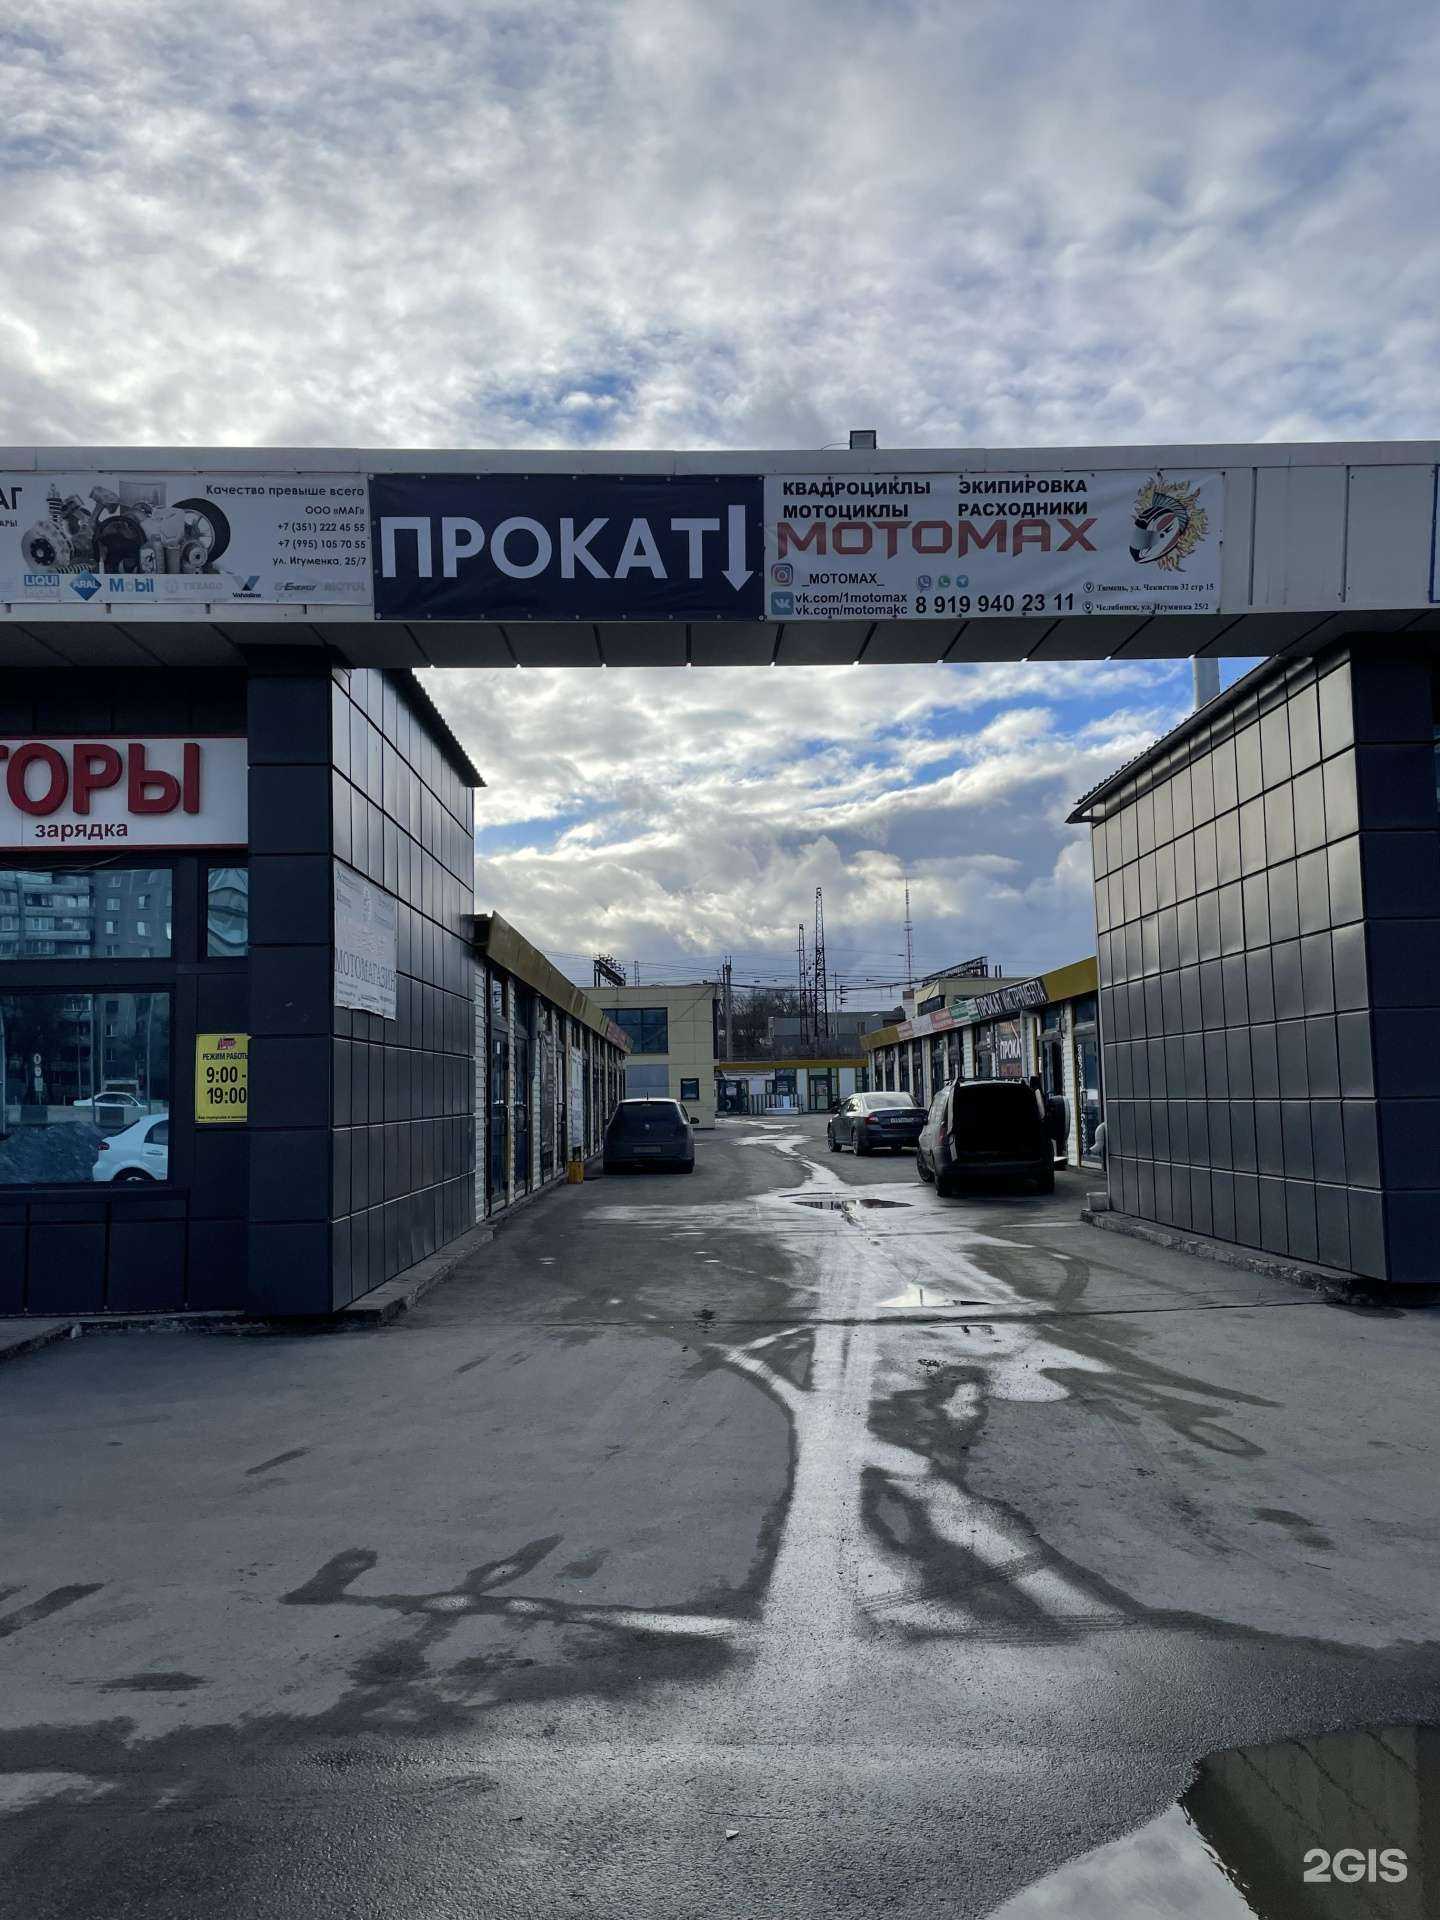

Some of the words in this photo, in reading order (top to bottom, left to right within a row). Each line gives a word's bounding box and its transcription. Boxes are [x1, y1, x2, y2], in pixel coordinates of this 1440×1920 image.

[206, 484, 265, 496] Качество
[268, 487, 327, 498] превыше
[329, 487, 365, 496] всего
[783, 480, 931, 498] КВАДРОЦИКЛЫ
[958, 479, 1088, 494] ЭКИПИРОВКА
[305, 505, 331, 515] ООО
[783, 503, 909, 519] МОТОЦИКЛЫ
[958, 501, 1088, 518] РАСХОДНИКИ
[278, 523, 289, 532] +7
[291, 522, 317, 534] (351)
[319, 523, 337, 532] 222
[339, 523, 351, 532] 45
[353, 523, 365, 532] 55
[278, 539, 290, 549] +7
[292, 539, 318, 551] (995)
[320, 539, 338, 549] 105
[339, 539, 352, 549] 70
[354, 540, 366, 549] 55
[379, 515, 721, 578] ПРОКАТ
[777, 518, 1098, 560] MOTOMAX
[272, 557, 287, 567] ул.
[344, 556, 367, 567] 25/7
[25, 575, 59, 586] LIQUI
[73, 580, 98, 589] ARAL
[1206, 583, 1214, 591] 15
[795, 592, 907, 604] vk.com/1motomax
[915, 596, 927, 613] 8
[934, 595, 971, 613] 919
[978, 594, 1015, 612] 940
[1021, 593, 1046, 612] 23
[1054, 592, 1074, 611] 11
[795, 604, 908, 615] vk.com/motomakc
[34, 822, 129, 840] зарядка
[335, 946, 396, 992] МОТОМАГАЗИН
[976, 992, 1003, 1017] ПРОКАТ
[999, 1038, 1021, 1060] ПРОКА
[206, 1066, 238, 1083] 9:00
[207, 1087, 247, 1105] 19:00
